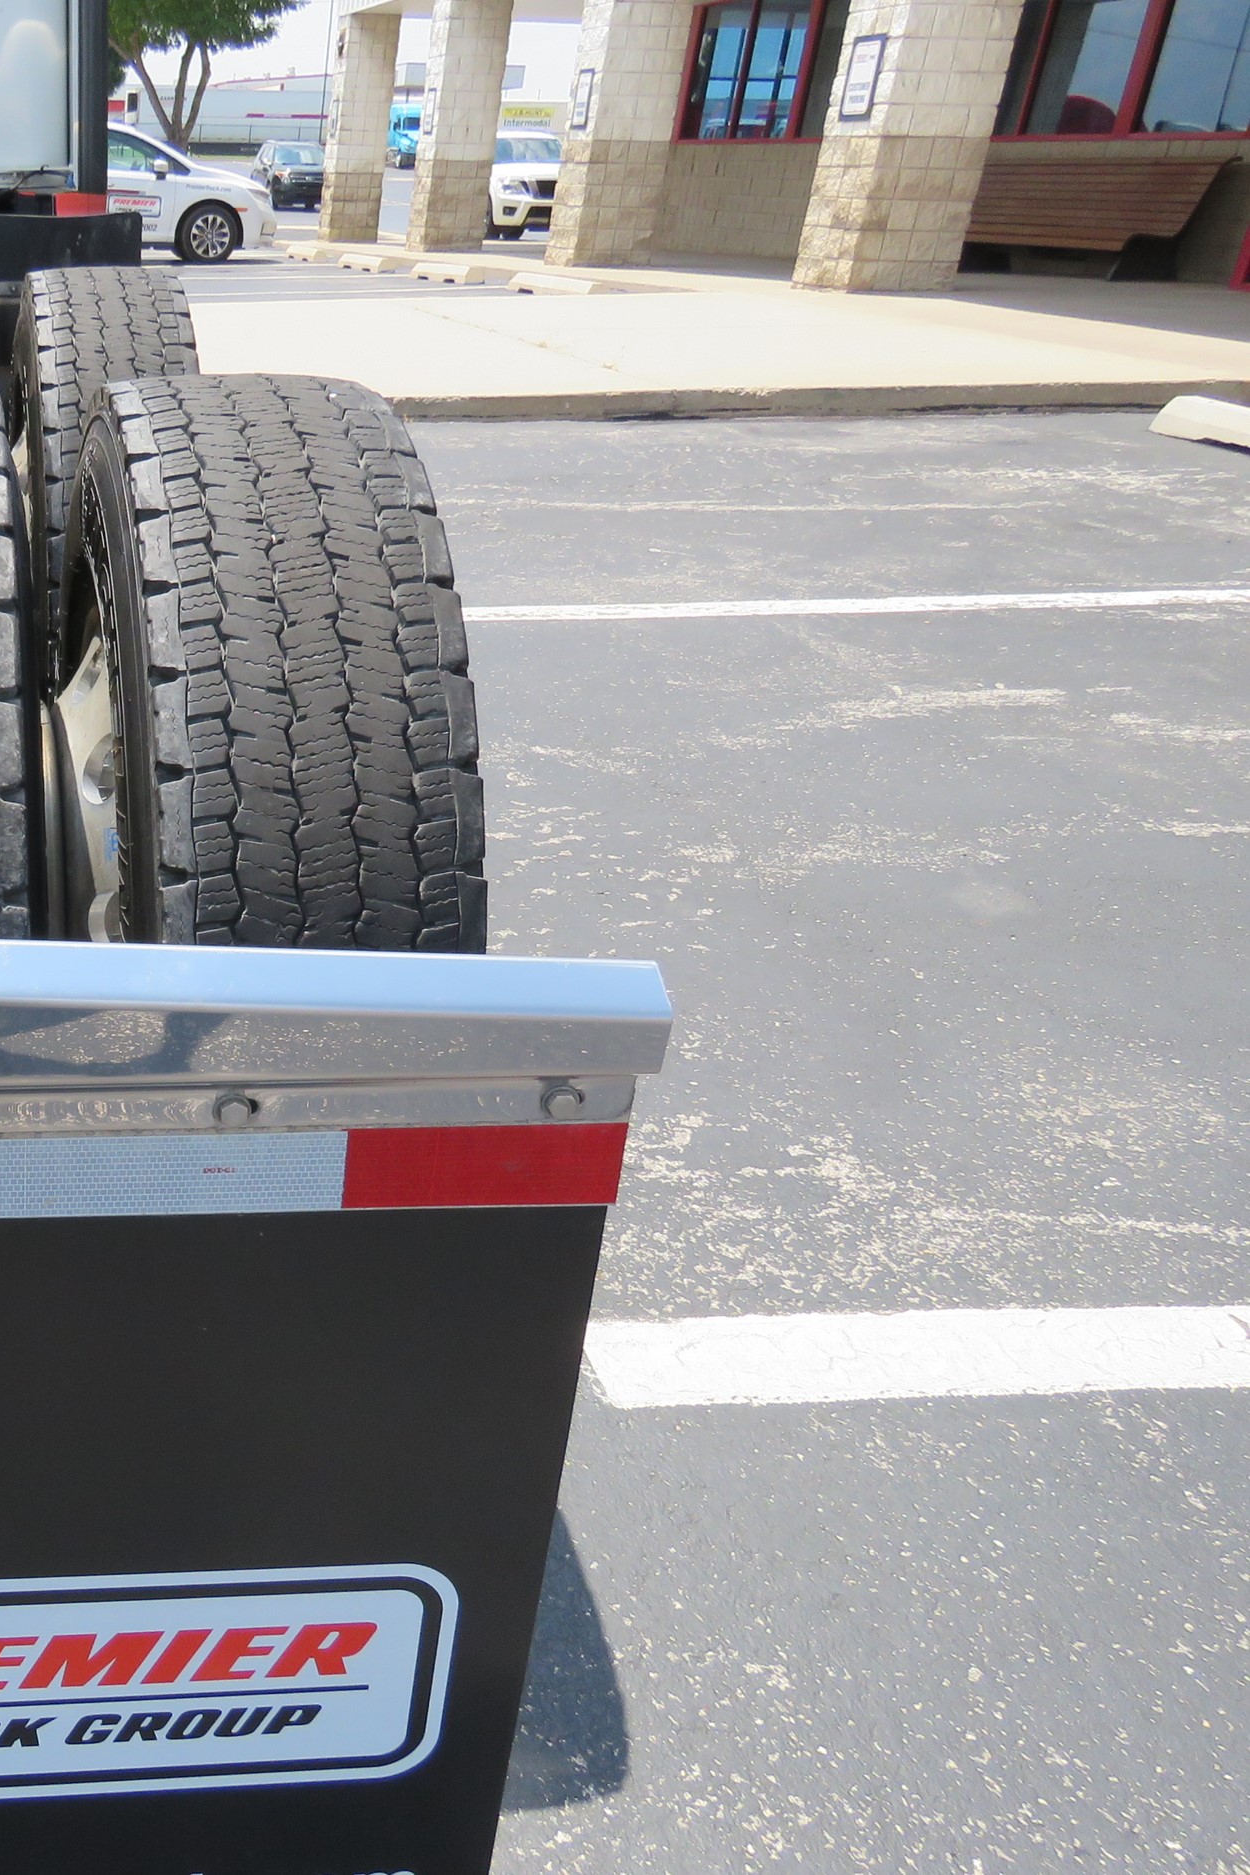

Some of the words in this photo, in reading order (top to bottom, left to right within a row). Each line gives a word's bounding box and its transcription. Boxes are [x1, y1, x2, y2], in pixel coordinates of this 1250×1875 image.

[503, 118, 551, 128] Intermodal
[186, 184, 232, 192] PremierTruck.com
[113, 198, 157, 206] PREMIER
[64, 1704, 322, 1745] GROUP
